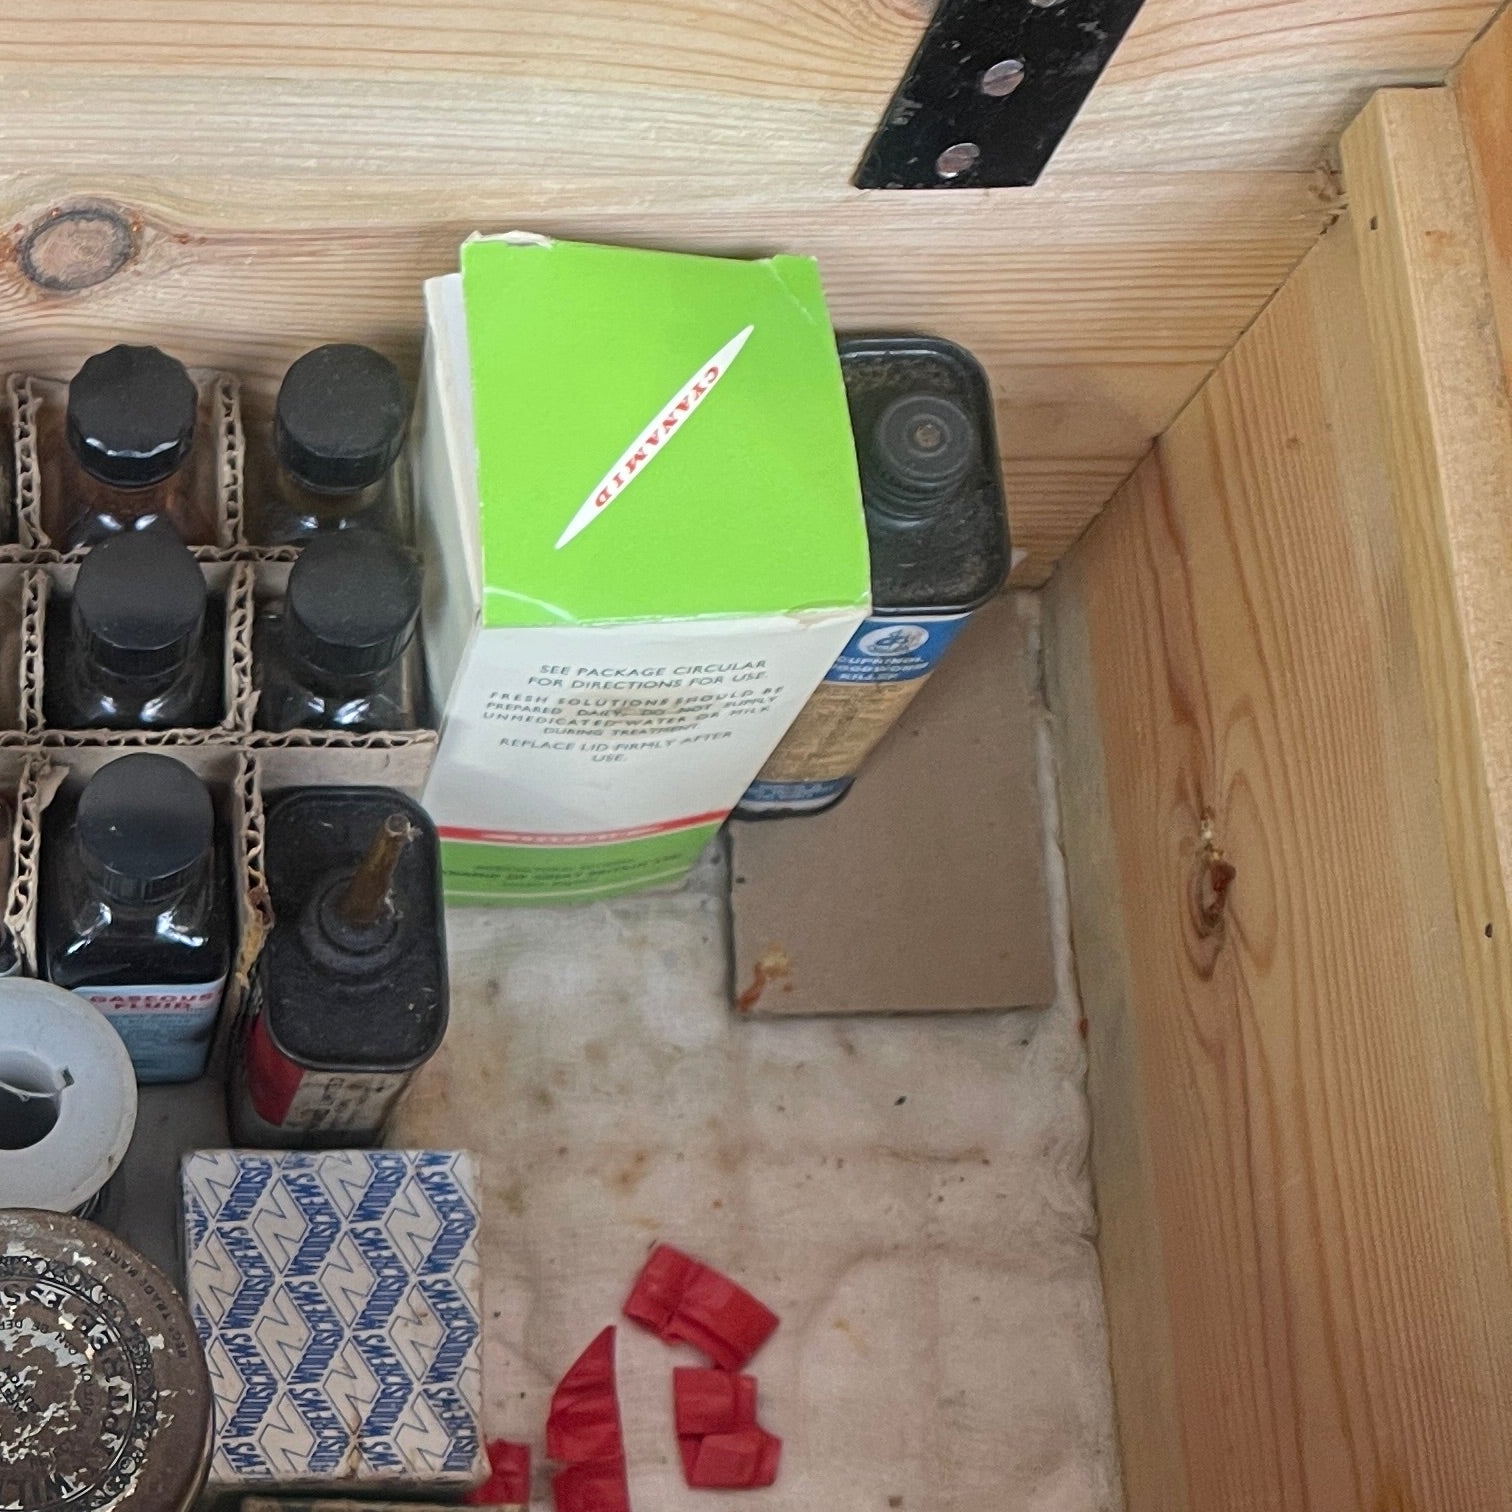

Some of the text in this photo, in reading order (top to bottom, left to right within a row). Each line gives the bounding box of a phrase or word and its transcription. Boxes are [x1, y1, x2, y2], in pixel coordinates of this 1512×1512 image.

[595, 366, 719, 507] CYANAMID
[540, 660, 766, 677] SEE PACKAGE CIRCULAR
[528, 676, 563, 688] FOR
[571, 678, 682, 690] DIRECTIONS
[690, 676, 724, 687] FOR
[489, 691, 549, 703] FRESH
[558, 697, 668, 707] SOLUTIONS
